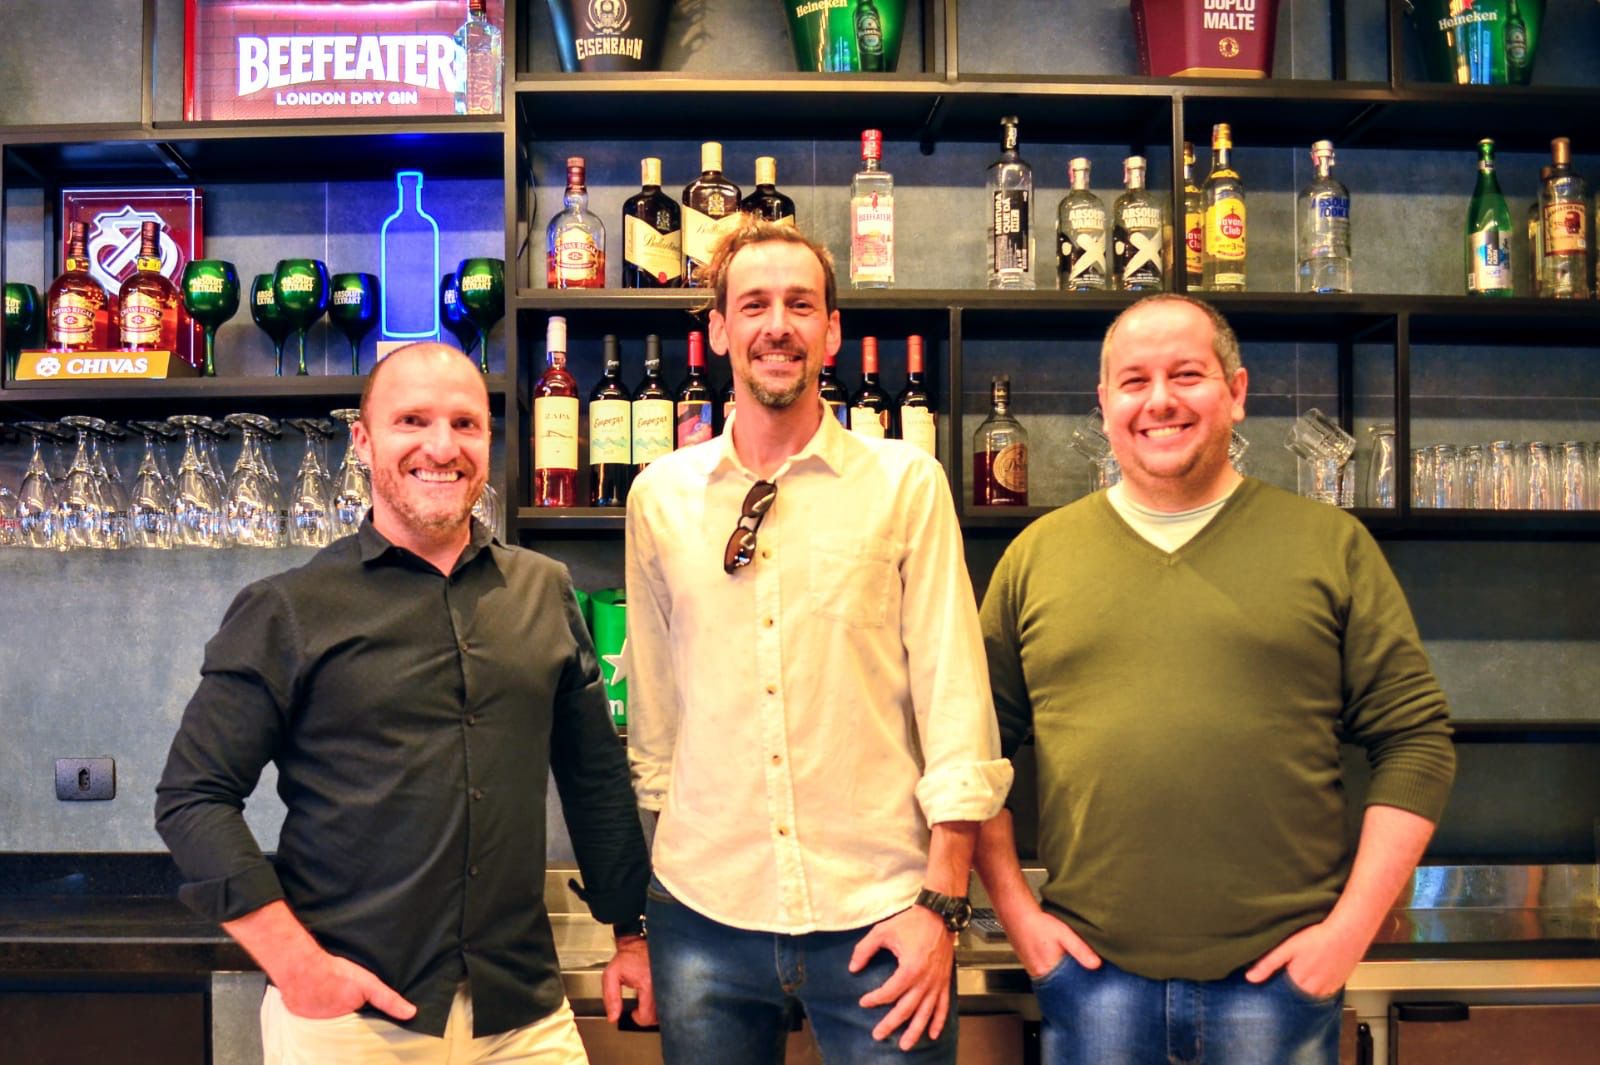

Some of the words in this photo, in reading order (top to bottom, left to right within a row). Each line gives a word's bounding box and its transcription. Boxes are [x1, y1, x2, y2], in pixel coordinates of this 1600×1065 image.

[796, 0, 848, 17] Heineken
[1204, 0, 1255, 11] DUPLO
[1203, 12, 1255, 31] MALTE
[1439, 11, 1497, 30] Heineken
[575, 37, 643, 60] EISENBAHN
[237, 35, 464, 97] BEEFEATER
[276, 92, 345, 105] LONDON
[350, 92, 384, 105] DRY
[387, 91, 417, 105] GIN
[1223, 226, 1241, 236] Club
[66, 357, 148, 374] CHIVAS
